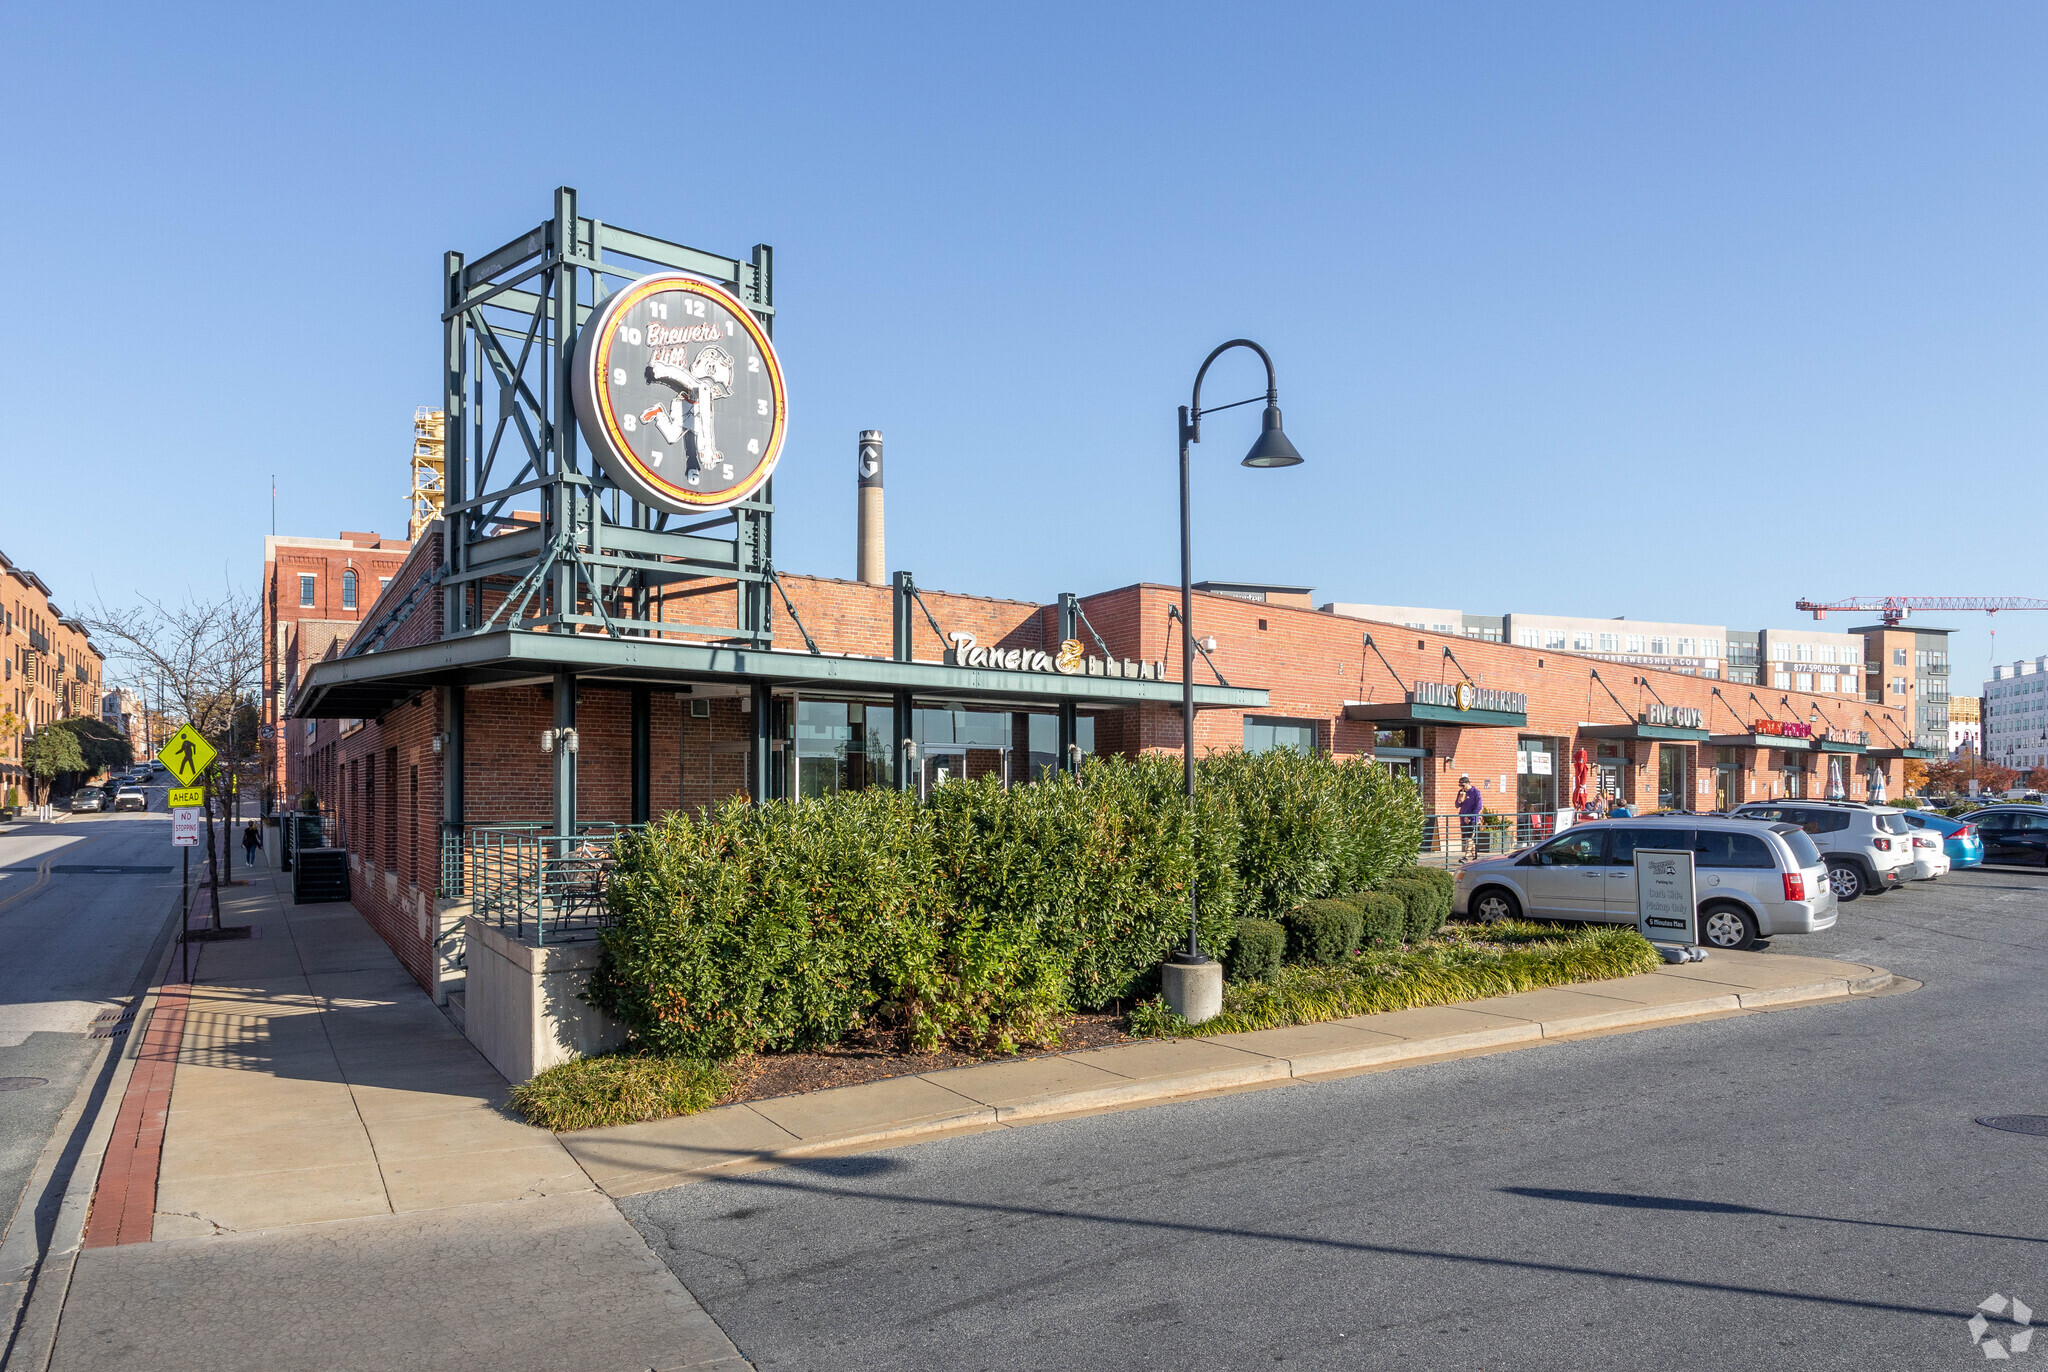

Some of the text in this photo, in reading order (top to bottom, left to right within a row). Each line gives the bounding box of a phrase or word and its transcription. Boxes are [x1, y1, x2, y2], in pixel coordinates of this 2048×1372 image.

[649, 301, 667, 320] 11
[684, 298, 705, 318] 12
[620, 325, 642, 346] 10
[646, 321, 723, 347] Brewers
[725, 320, 734, 337] 1
[748, 356, 759, 373] 2
[613, 367, 627, 386] 9
[757, 399, 768, 416] 3
[623, 413, 637, 432] 8
[747, 438, 759, 455] 4
[651, 450, 663, 467] 7
[687, 468, 700, 486] 6
[722, 463, 734, 480] 5
[949, 632, 1164, 680] Panera BREAD
[25, 653, 35, 688] domain
[1794, 663, 1840, 674] 877.590.8685
[55, 672, 64, 703] domain
[1416, 681, 1457, 707] FLOYD'S
[1471, 687, 1528, 713] BARBERSHOP
[1650, 704, 1704, 729] FIVE GUYS
[173, 792, 200, 802] AHEAD
[181, 812, 192, 821] NO
[175, 824, 197, 832] STOPPING
[1649, 889, 1684, 900] Curb Side
[1646, 902, 1688, 915] Pickup Only
[1654, 919, 1673, 927] Minutes
[1673, 920, 1684, 928] Max
